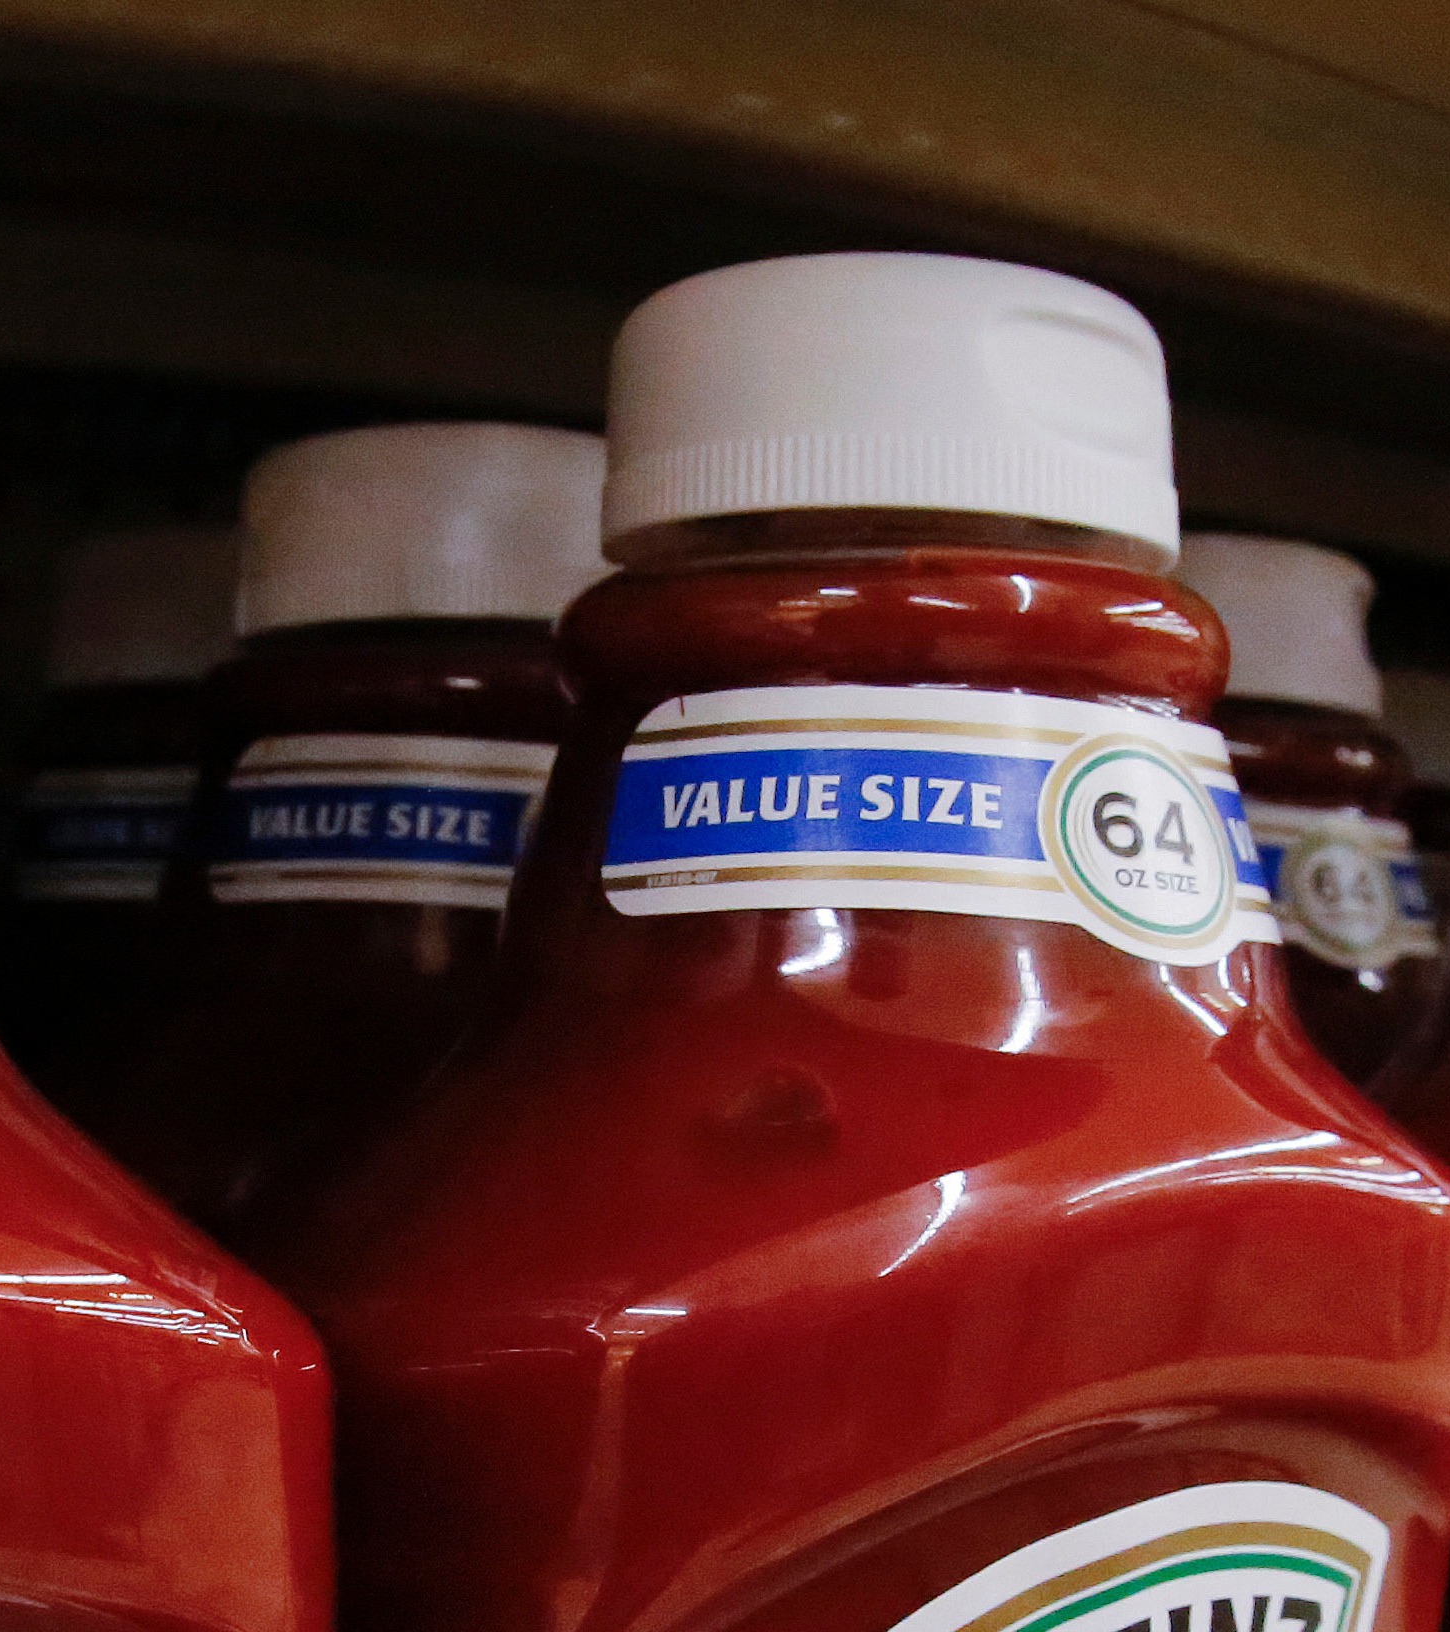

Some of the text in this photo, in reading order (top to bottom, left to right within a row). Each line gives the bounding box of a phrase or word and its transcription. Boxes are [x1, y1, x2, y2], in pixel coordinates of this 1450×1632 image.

[251, 800, 492, 847] VALUE SIZE
[662, 773, 1003, 831] VALUE SIZE
[1092, 791, 1194, 866] 64
[1115, 868, 1201, 895] OZ SIZE
